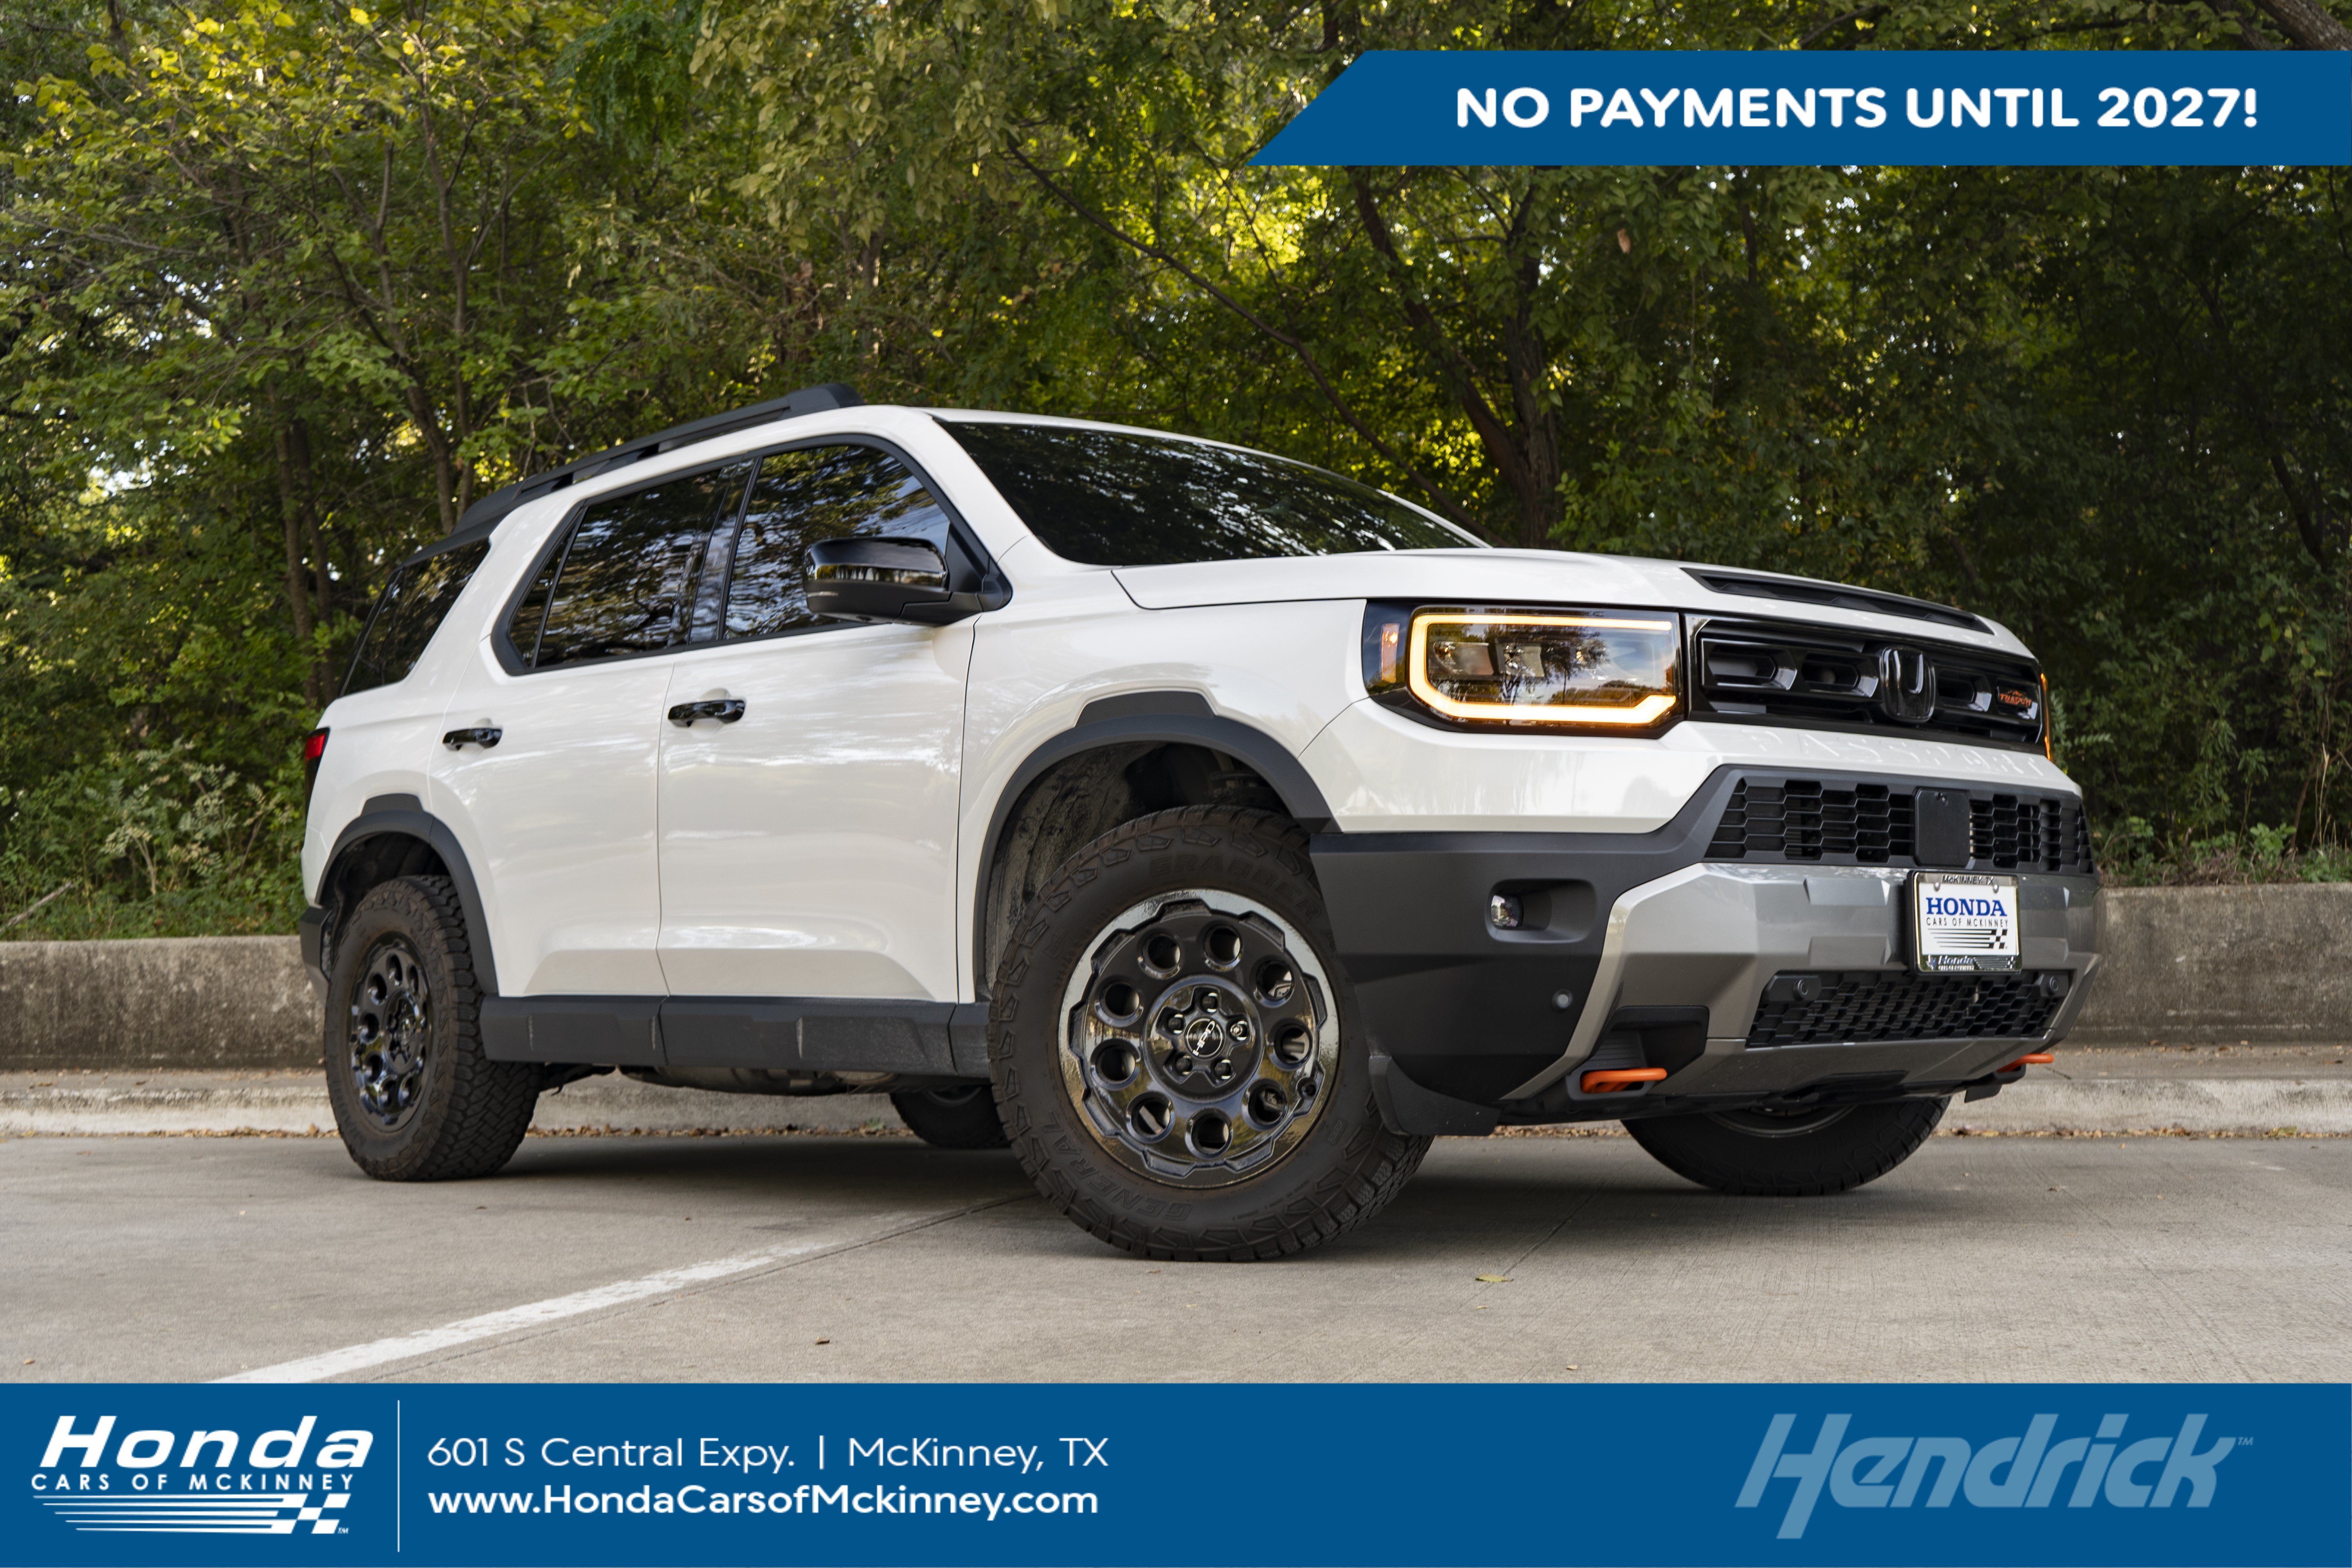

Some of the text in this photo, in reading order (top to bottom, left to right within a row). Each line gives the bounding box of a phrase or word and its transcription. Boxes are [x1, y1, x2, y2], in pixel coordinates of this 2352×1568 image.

[1740, 730, 2044, 777] PASSPORT
[1149, 854, 1321, 920] GRABBER
[1985, 876, 1994, 885] TX
[1926, 897, 2007, 916] HONDA
[1927, 917, 1947, 925] CARS
[1967, 919, 2008, 927] MCKINNEY
[1043, 1111, 1193, 1221] GENERAL
